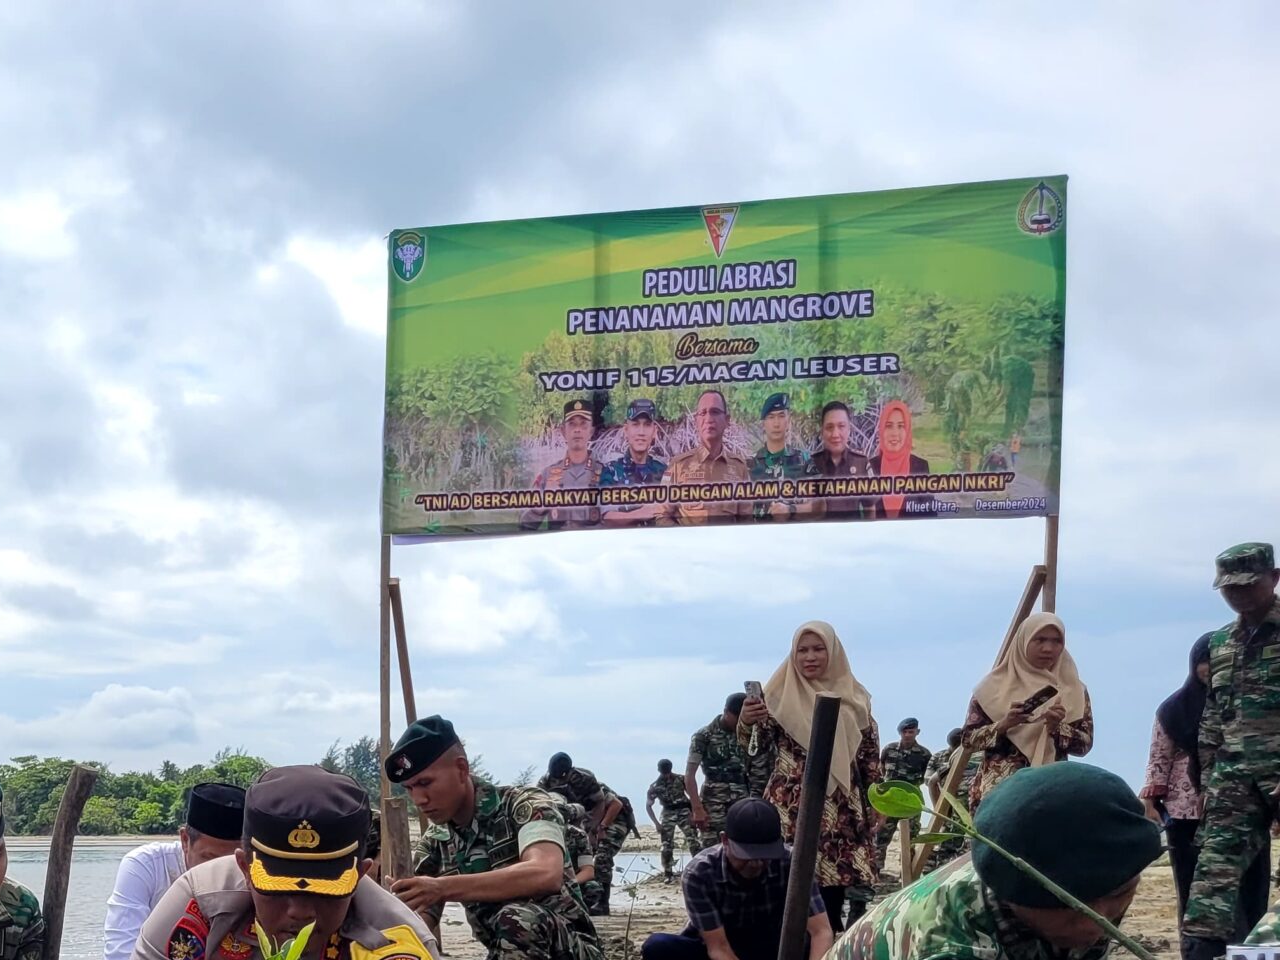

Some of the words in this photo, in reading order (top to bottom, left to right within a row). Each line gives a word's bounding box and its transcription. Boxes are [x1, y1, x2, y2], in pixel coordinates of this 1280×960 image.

[643, 265, 716, 297] PEDULI
[719, 260, 795, 292] ABRASI
[568, 300, 723, 334] PENANAMAN
[728, 292, 873, 324] MANGROVE
[676, 333, 759, 359] Bersama
[540, 369, 620, 391] YONIF
[626, 360, 786, 388] 115/MACAN
[793, 355, 899, 378] LEUSER
[450, 493, 470, 509] AD
[473, 491, 542, 508] BERSAMA
[544, 489, 599, 506] RAKYAT
[601, 487, 667, 503] BERSATU
[670, 484, 732, 501] DENGAN
[735, 482, 778, 499] ALAM
[781, 481, 795, 497] &
[797, 477, 891, 496] KETAHANAN
[895, 475, 961, 494] PANGAN
[905, 500, 929, 513] Kluet
[931, 499, 960, 514] Utara,
[975, 498, 1021, 512] Desember
[1022, 497, 1047, 511] 2024
